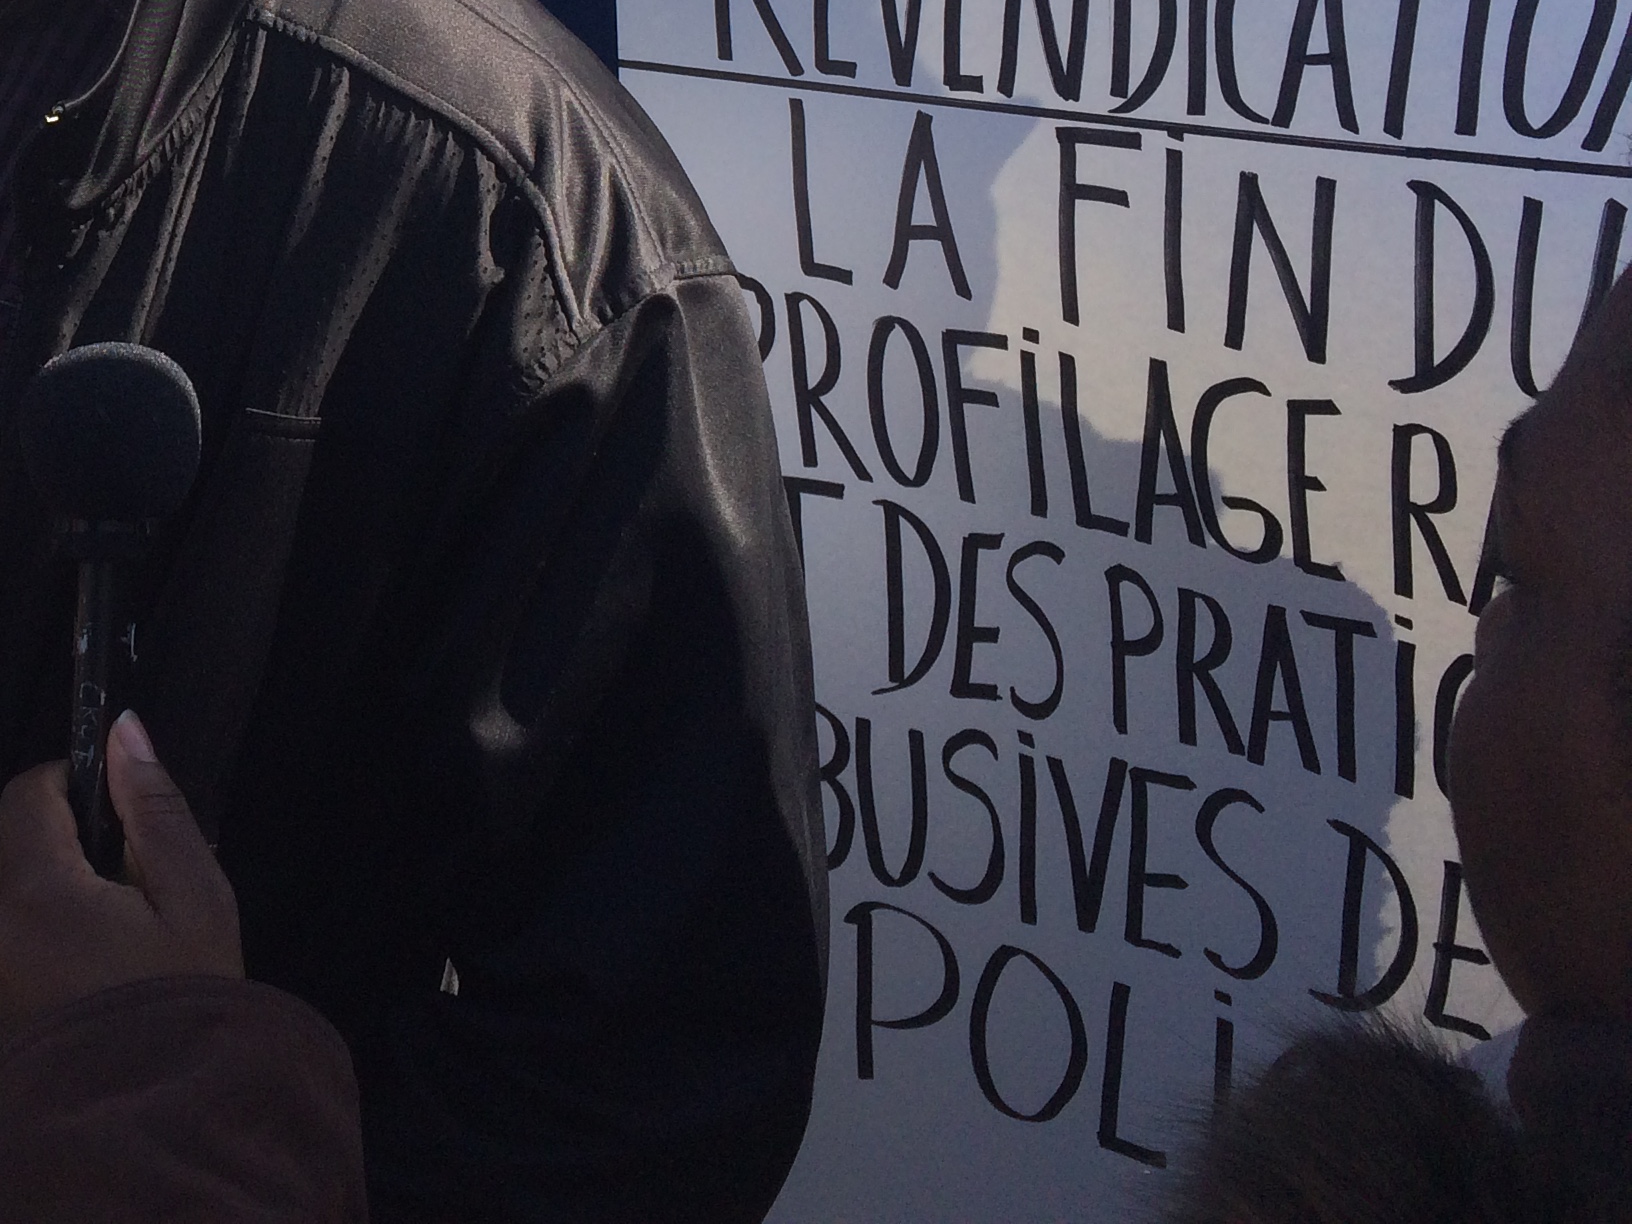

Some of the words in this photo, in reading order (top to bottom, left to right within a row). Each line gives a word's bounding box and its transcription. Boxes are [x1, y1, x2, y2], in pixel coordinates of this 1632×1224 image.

[788, 97, 973, 301] LA
[1055, 124, 1337, 366] FIN
[872, 498, 1066, 722] DES
[1308, 818, 1492, 1042] DE
